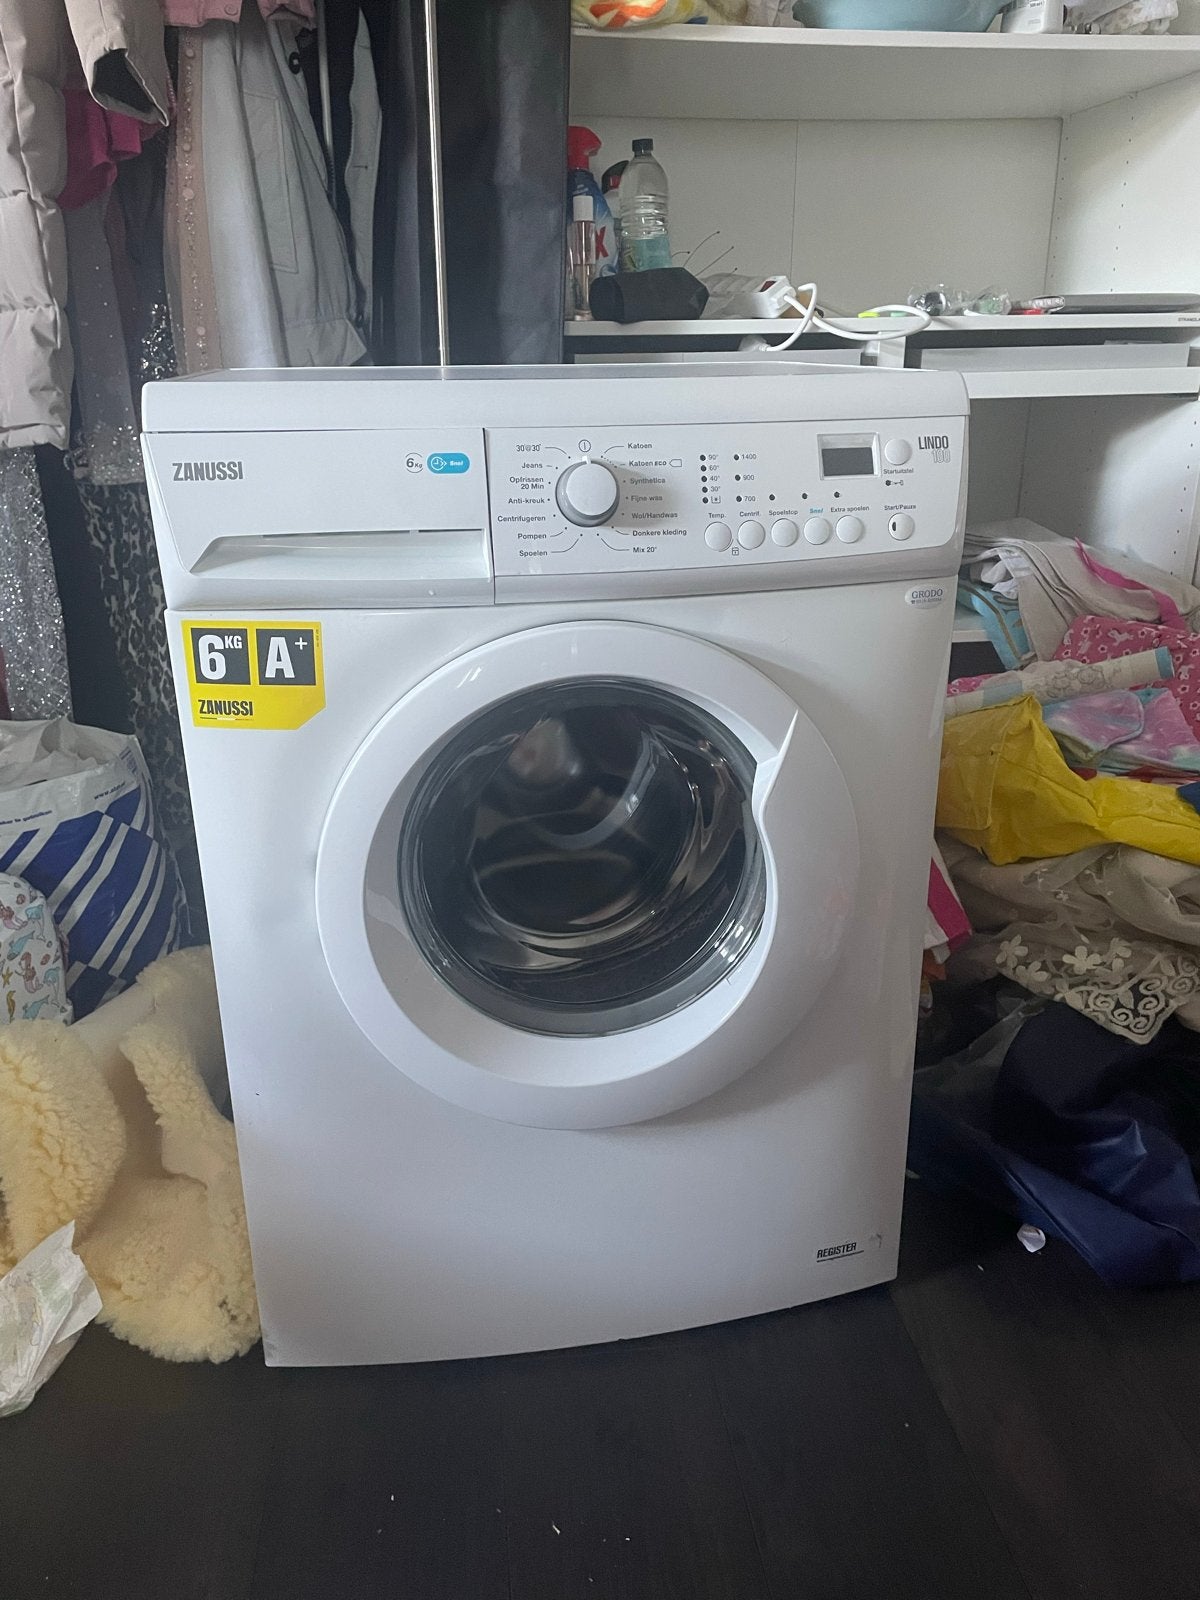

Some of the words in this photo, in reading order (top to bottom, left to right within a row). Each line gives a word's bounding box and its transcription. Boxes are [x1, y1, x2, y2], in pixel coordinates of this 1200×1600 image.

[918, 435, 949, 450] LINDO
[628, 459, 654, 467] Katoen
[172, 461, 244, 481] ZANUSSI
[509, 476, 544, 484] Opfrissen
[630, 477, 666, 485] Synthetica
[497, 515, 546, 523] Centrifugeren
[517, 532, 547, 540] Pompen
[632, 529, 661, 537] Donkere
[911, 588, 944, 599] GRODO
[198, 699, 254, 716] ZANUSSI
[816, 1242, 857, 1259] REGISTER
